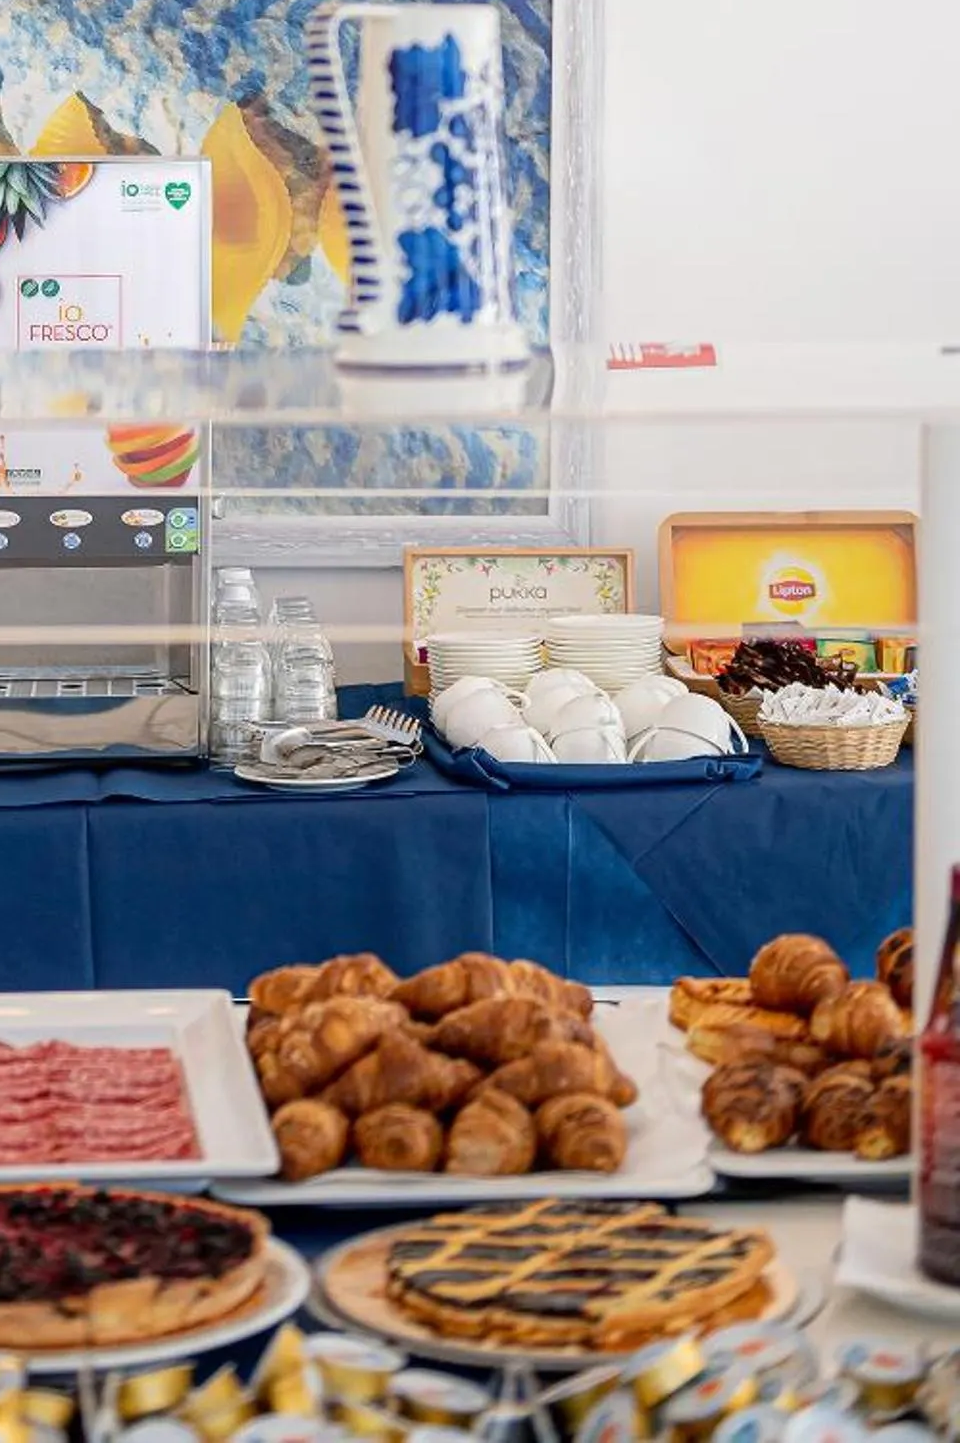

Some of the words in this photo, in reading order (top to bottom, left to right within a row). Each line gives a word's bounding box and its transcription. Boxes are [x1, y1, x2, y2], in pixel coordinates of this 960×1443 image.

[30, 324, 109, 341] FRESCO
[489, 585, 547, 603] pukka
[773, 584, 812, 597] Lipton
